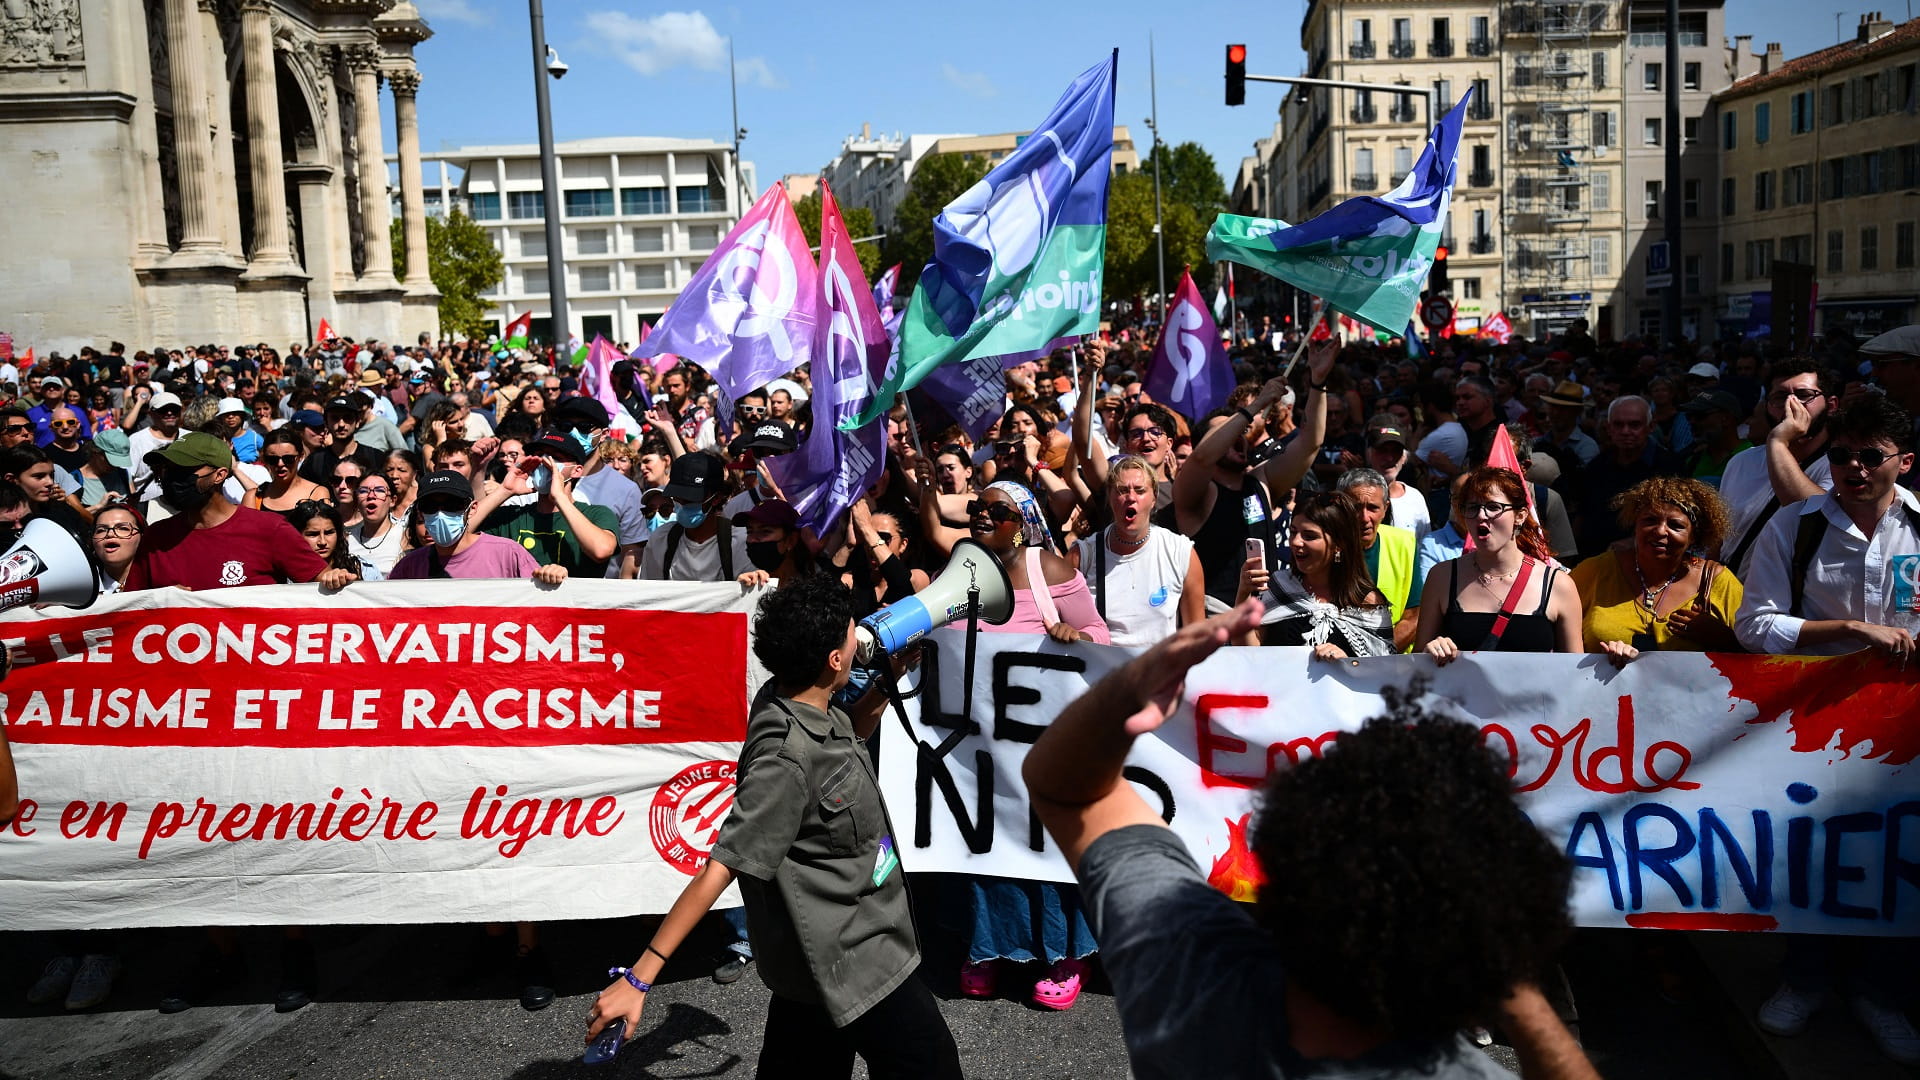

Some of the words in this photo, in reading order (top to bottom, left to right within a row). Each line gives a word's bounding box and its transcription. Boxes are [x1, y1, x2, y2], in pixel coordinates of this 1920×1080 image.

[49, 627, 113, 664] LE
[132, 622, 624, 672] CONSERVATISME,
[234, 688, 302, 730] ET
[318, 688, 381, 730] LE
[402, 687, 661, 731] RACISME
[919, 638, 1087, 744] LE
[664, 765, 712, 803] JEUNE
[59, 800, 128, 842] en
[138, 786, 439, 860] première
[460, 784, 625, 859] ligne
